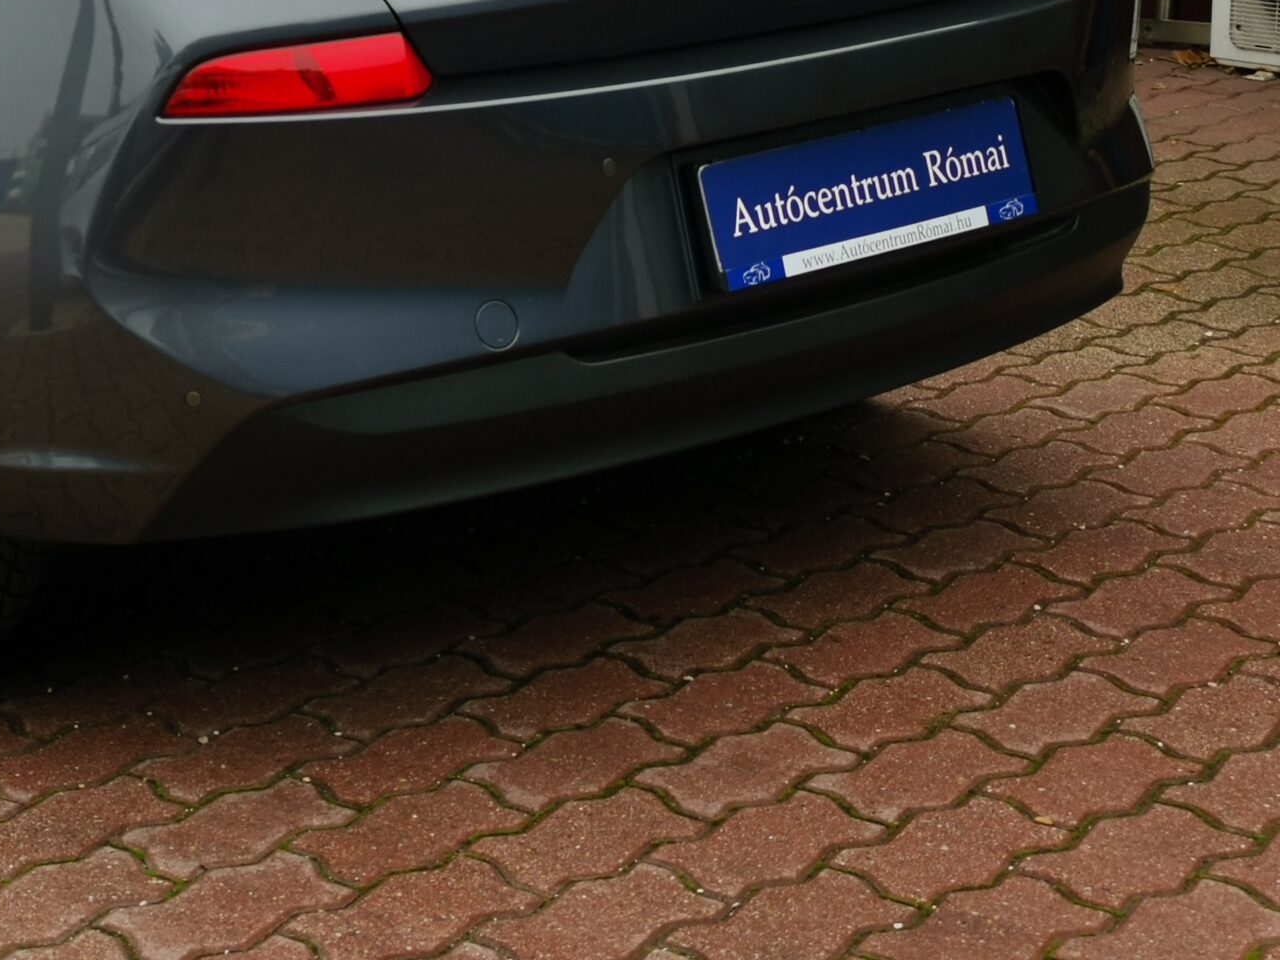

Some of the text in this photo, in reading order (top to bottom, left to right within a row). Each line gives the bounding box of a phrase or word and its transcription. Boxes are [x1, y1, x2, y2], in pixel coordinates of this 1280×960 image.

[732, 134, 1011, 238] Autócentrum Római
[801, 214, 972, 270] www.AutócentrumRómai.hu
